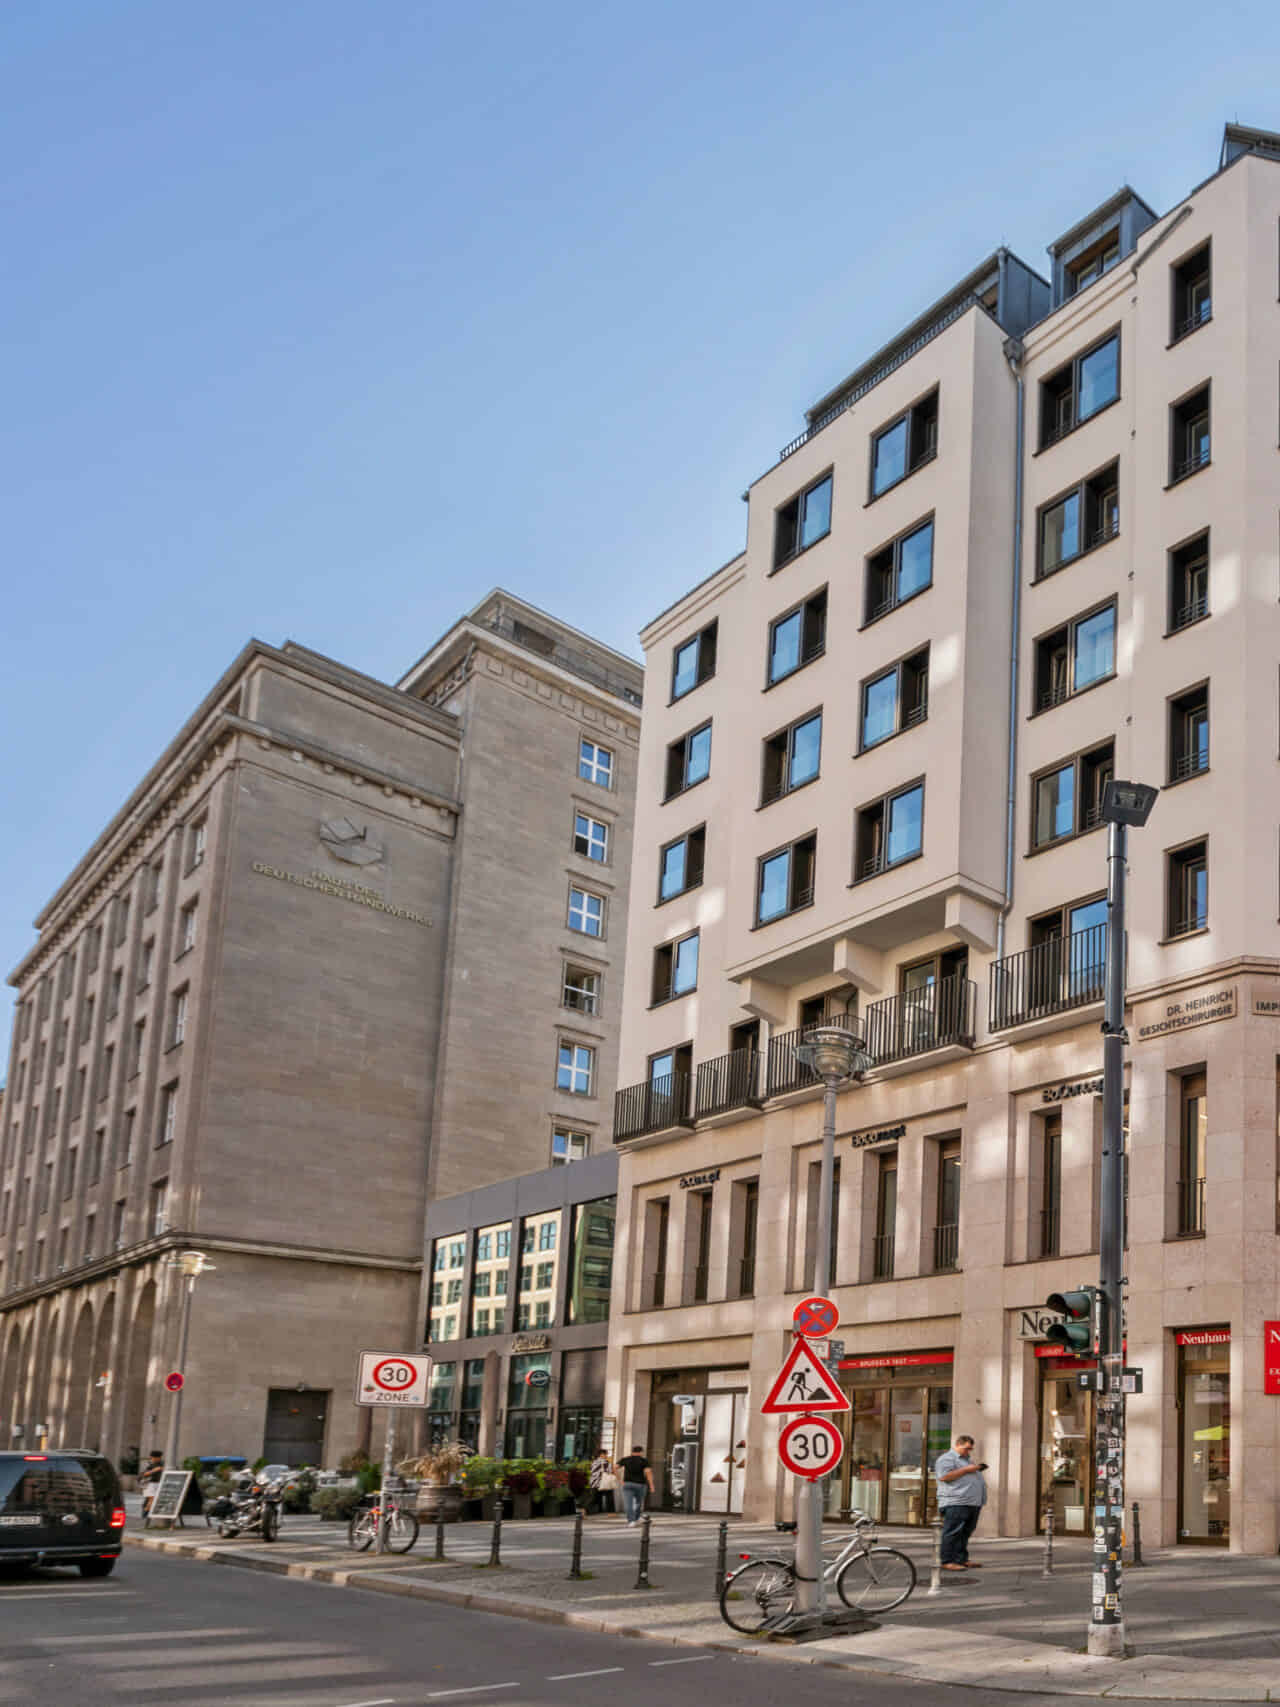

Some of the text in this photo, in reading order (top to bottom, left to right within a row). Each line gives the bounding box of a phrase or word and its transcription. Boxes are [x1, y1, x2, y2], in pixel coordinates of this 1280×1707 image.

[1166, 991, 1233, 1018] DR. HEINRICH
[1139, 1004, 1233, 1037] GESICHTSCHIRURGIE
[381, 1367, 409, 1383] 30
[375, 1392, 410, 1402] ZONE
[792, 1432, 829, 1461] 30
